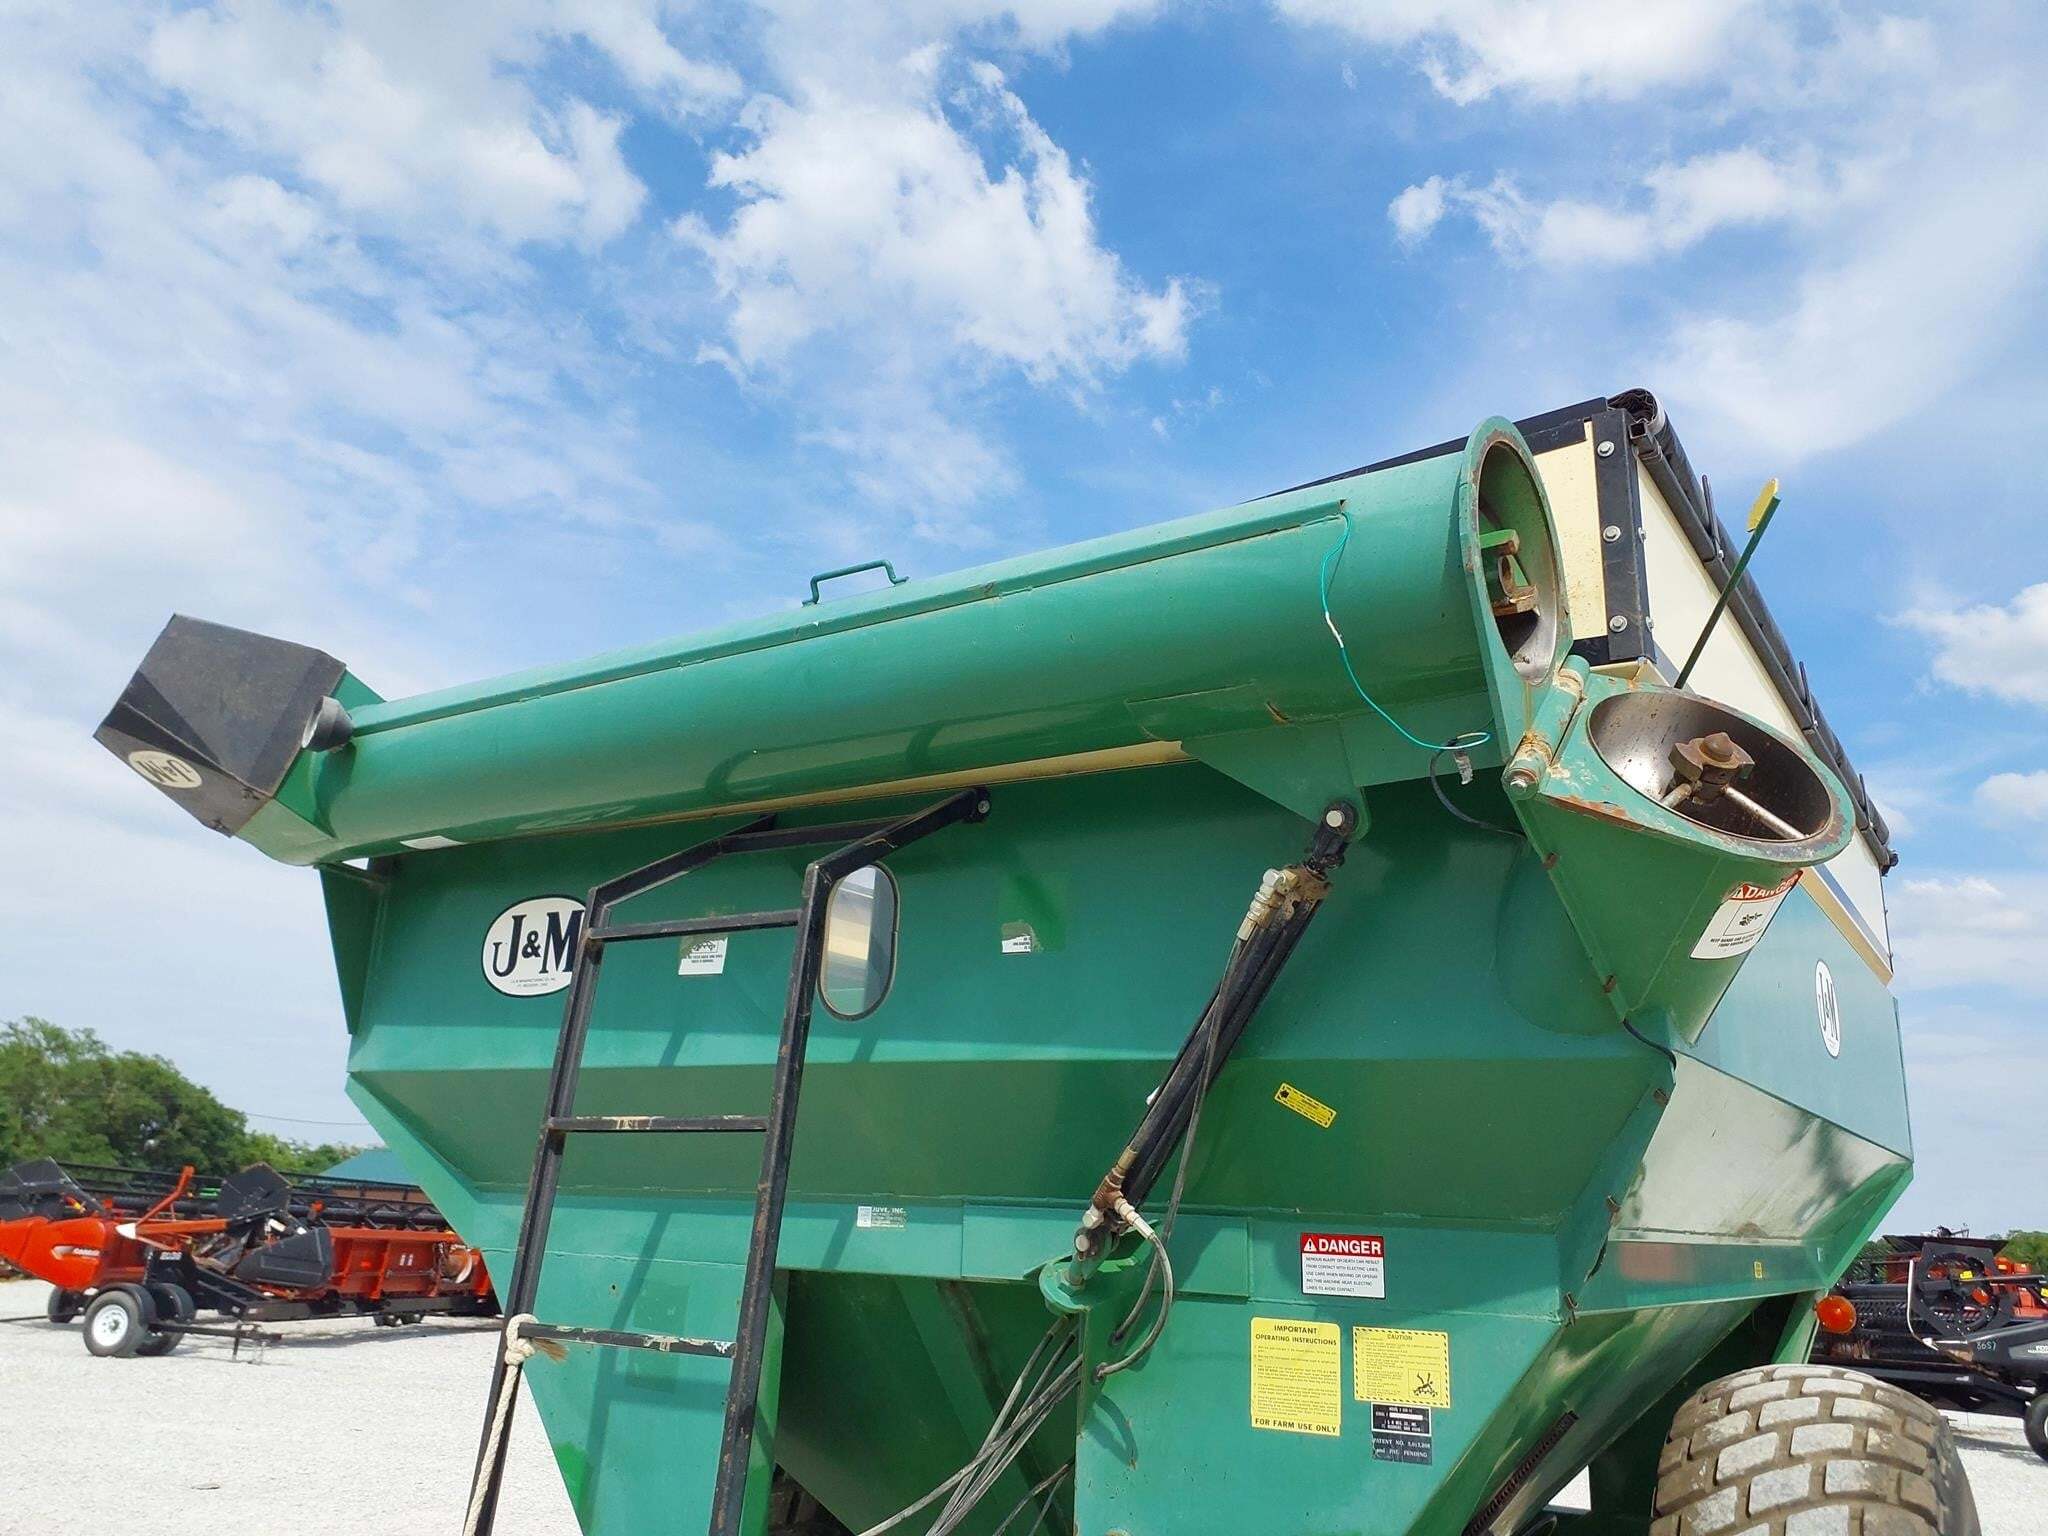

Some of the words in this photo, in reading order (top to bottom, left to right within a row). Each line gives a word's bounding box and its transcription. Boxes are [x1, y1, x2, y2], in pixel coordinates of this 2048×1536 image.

[492, 909, 585, 978] J&M
[1318, 1238, 1382, 1255] DANGER
[1274, 1324, 1317, 1334] IMPORTANT
[1255, 1333, 1290, 1342] OPERATING
[1292, 1336, 1337, 1346] INSTRUCTIONS
[1386, 1333, 1413, 1341] CAUTION
[1255, 1418, 1270, 1426] FOR
[1273, 1419, 1295, 1429] FARM
[1297, 1423, 1312, 1431] USE
[1316, 1424, 1337, 1433] ONLY
[1403, 1450, 1428, 1458] PENDING
